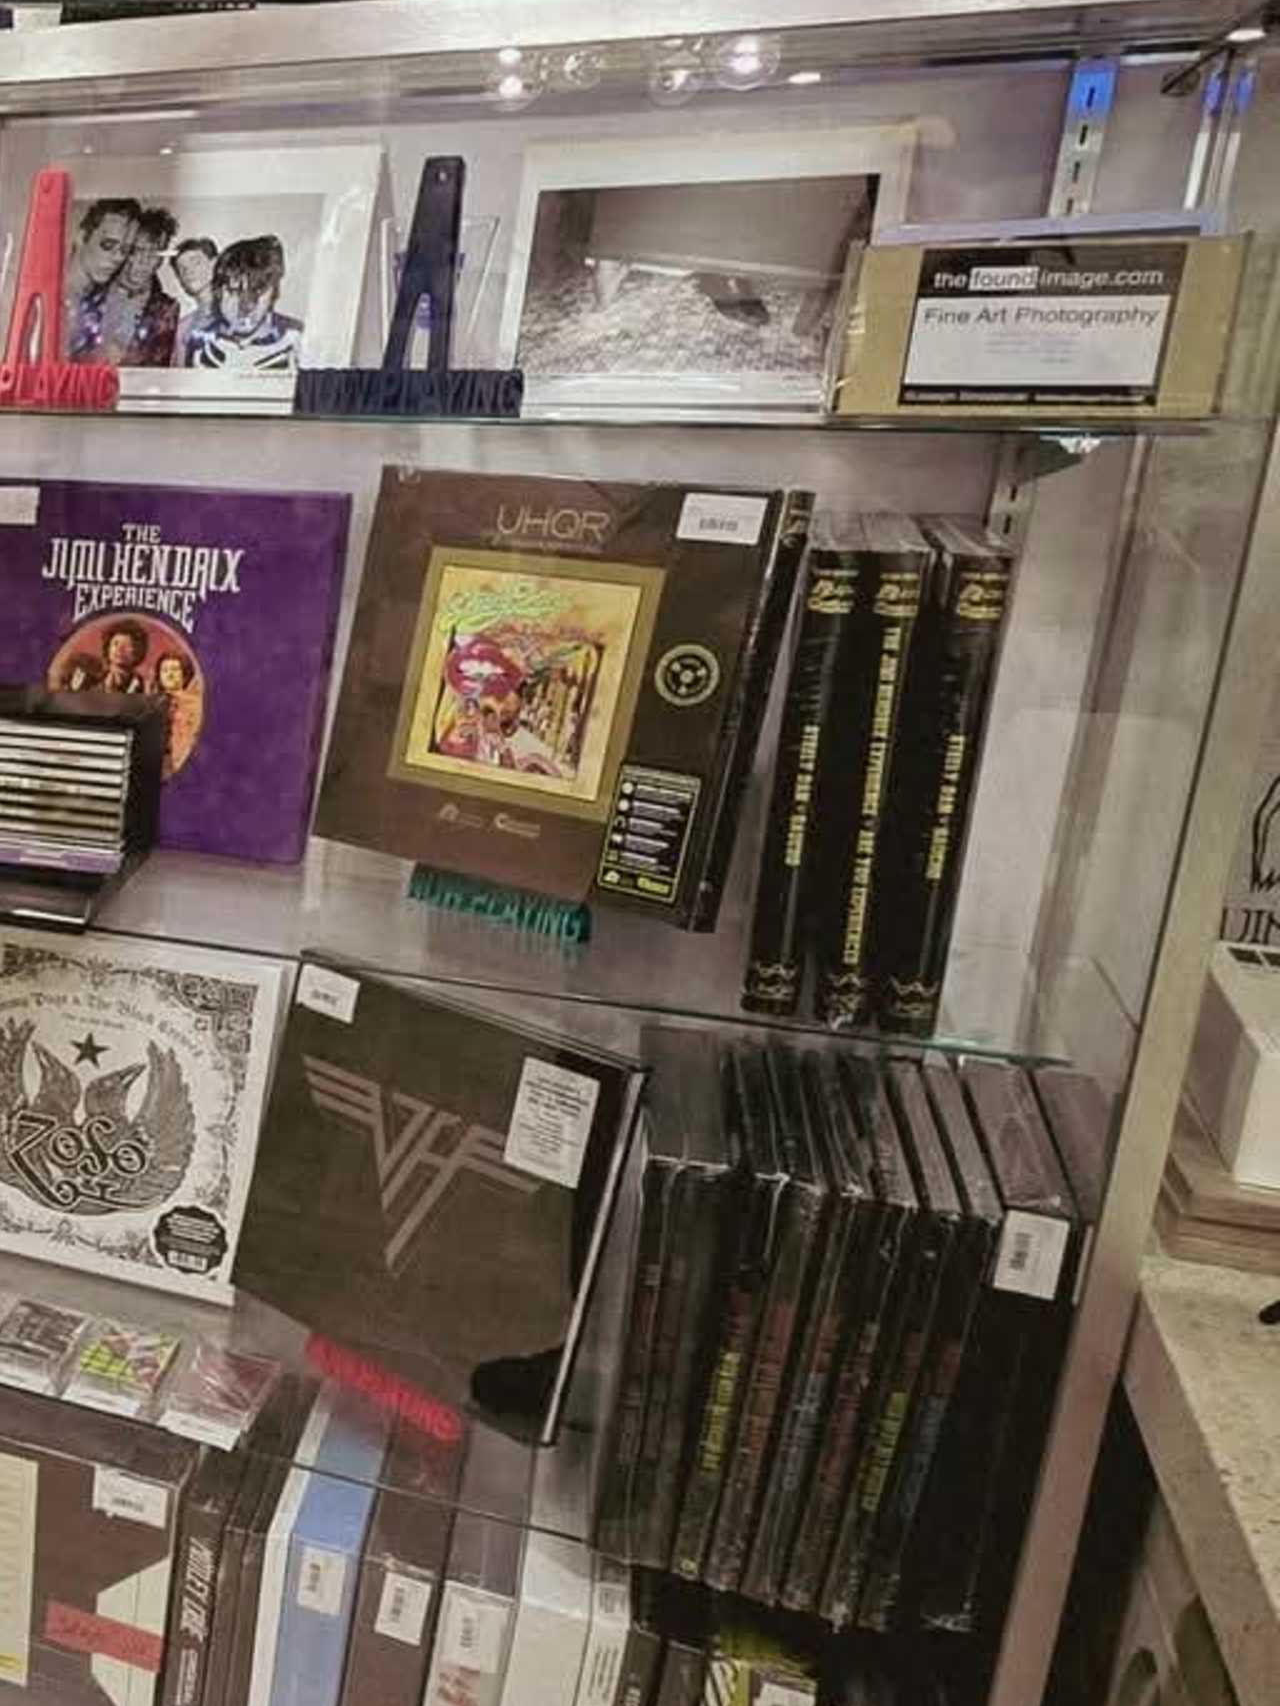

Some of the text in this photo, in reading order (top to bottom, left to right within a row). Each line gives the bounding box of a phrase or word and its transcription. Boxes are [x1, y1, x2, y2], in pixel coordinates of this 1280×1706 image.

[923, 303, 1160, 330] Fine Art Photography
[122, 523, 161, 544] THE
[496, 504, 612, 543] UHQR
[111, 541, 245, 597] HENDRIX
[72, 586, 198, 633] EXPERIENCE
